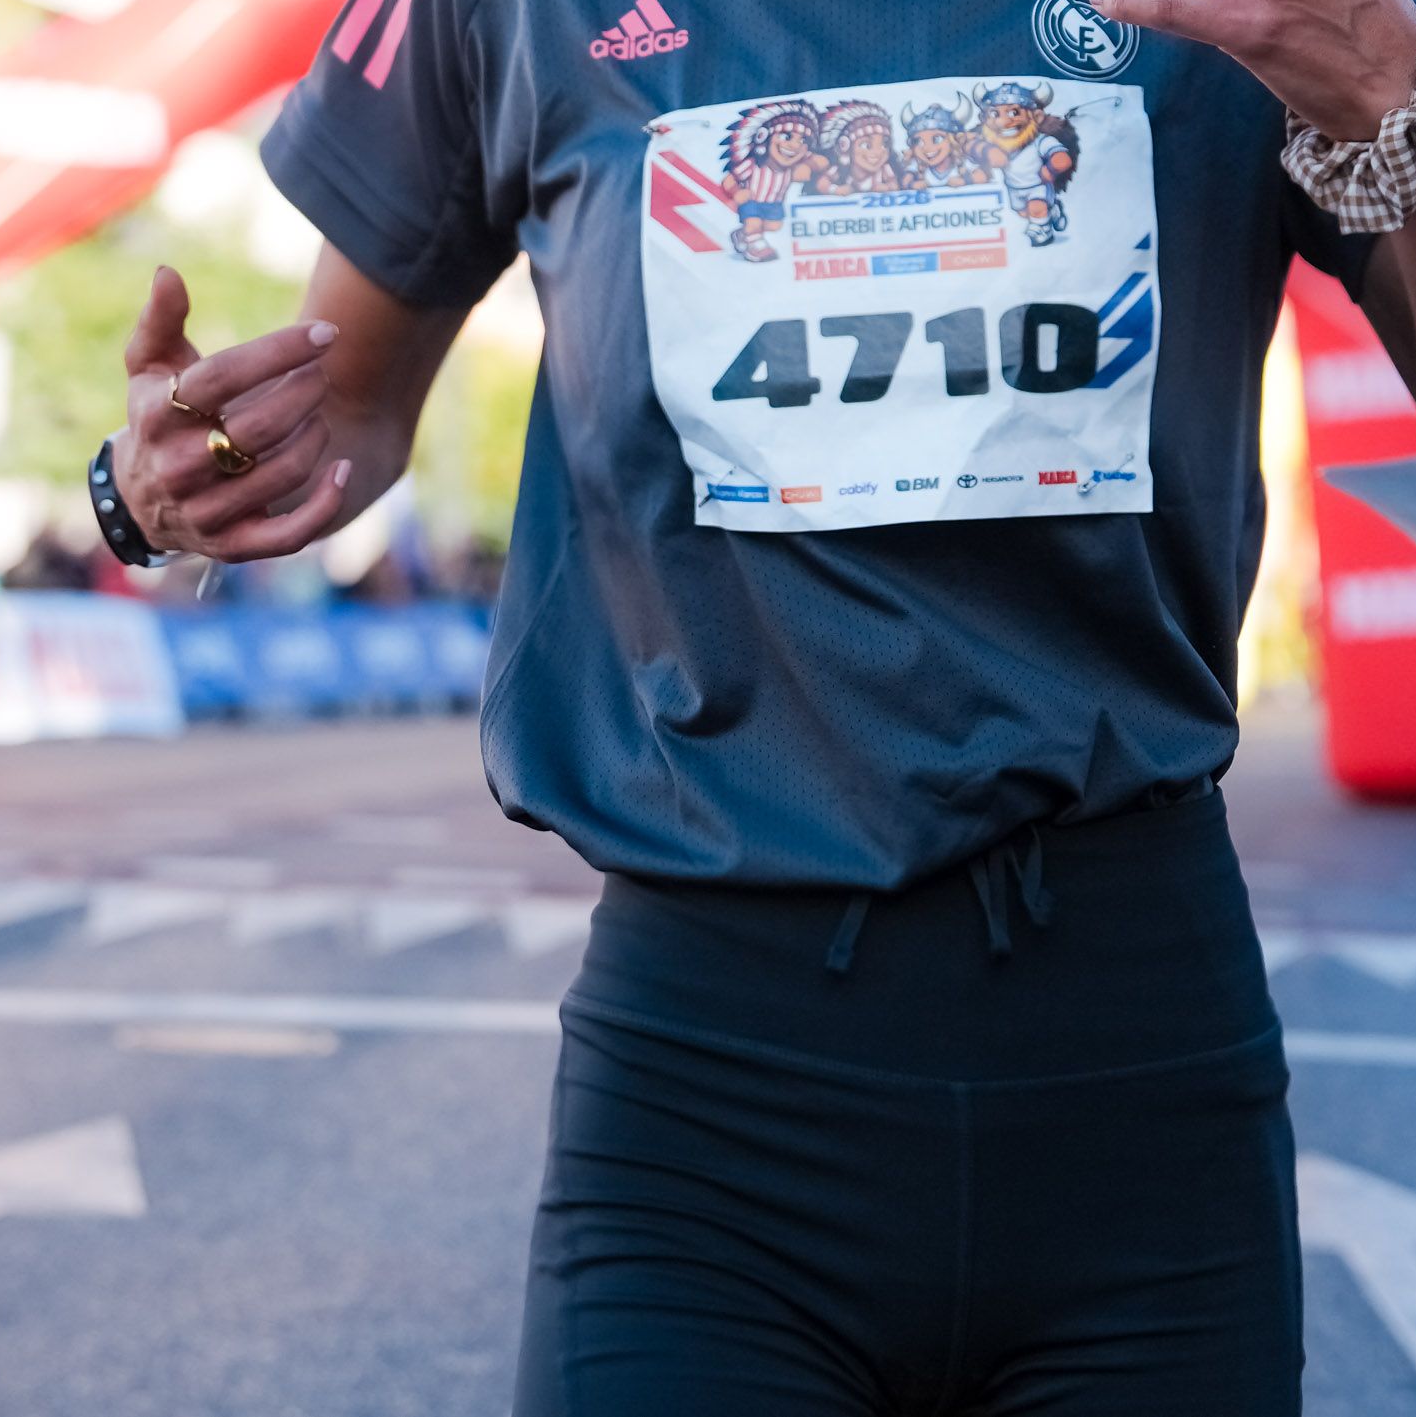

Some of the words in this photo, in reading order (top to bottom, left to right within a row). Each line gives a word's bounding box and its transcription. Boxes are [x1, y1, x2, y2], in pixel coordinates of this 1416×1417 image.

[589, 29, 689, 60] adidas
[862, 191, 931, 208] 2026
[791, 220, 814, 237] EL
[819, 218, 875, 235] DERBI
[899, 209, 1002, 232] AFICIONES
[794, 257, 869, 281] MARCA
[712, 303, 1100, 408] 4710
[913, 477, 939, 490] BM
[1039, 471, 1077, 485] MARCA
[839, 481, 878, 496] cabify
